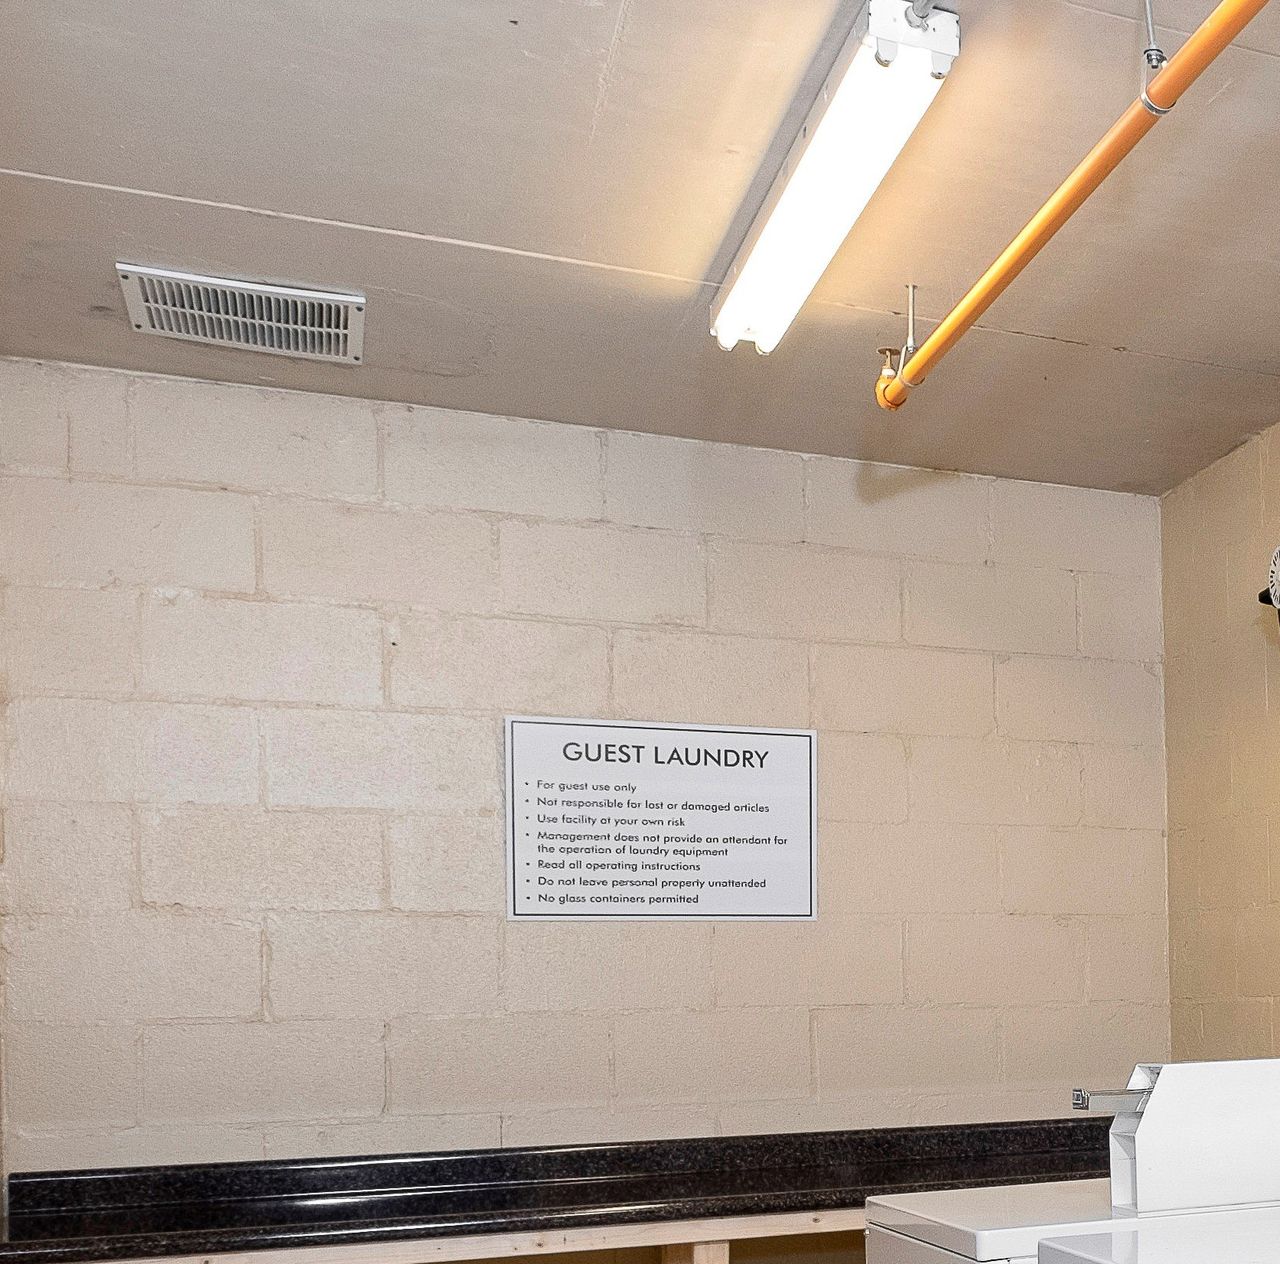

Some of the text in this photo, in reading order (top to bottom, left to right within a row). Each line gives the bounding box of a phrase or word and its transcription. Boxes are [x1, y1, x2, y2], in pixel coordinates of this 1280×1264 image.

[563, 742, 769, 769] GUEST LAUNDRY
[537, 780, 555, 789] For
[559, 782, 588, 792] guest
[614, 783, 637, 794] only
[537, 797, 770, 813] Not responsible for lost or damaged articles
[537, 814, 558, 824] Use
[562, 814, 597, 825] facility
[600, 817, 611, 825] at
[614, 819, 638, 827] your
[667, 818, 686, 826] risk
[537, 831, 788, 845] Management does not provide an attendant for
[537, 844, 728, 858] the operation of laundry equipment
[537, 859, 701, 872] Read all operating instructions
[538, 876, 767, 889] Do not leave personal property unattended
[538, 894, 699, 905] No glass containers permitted
